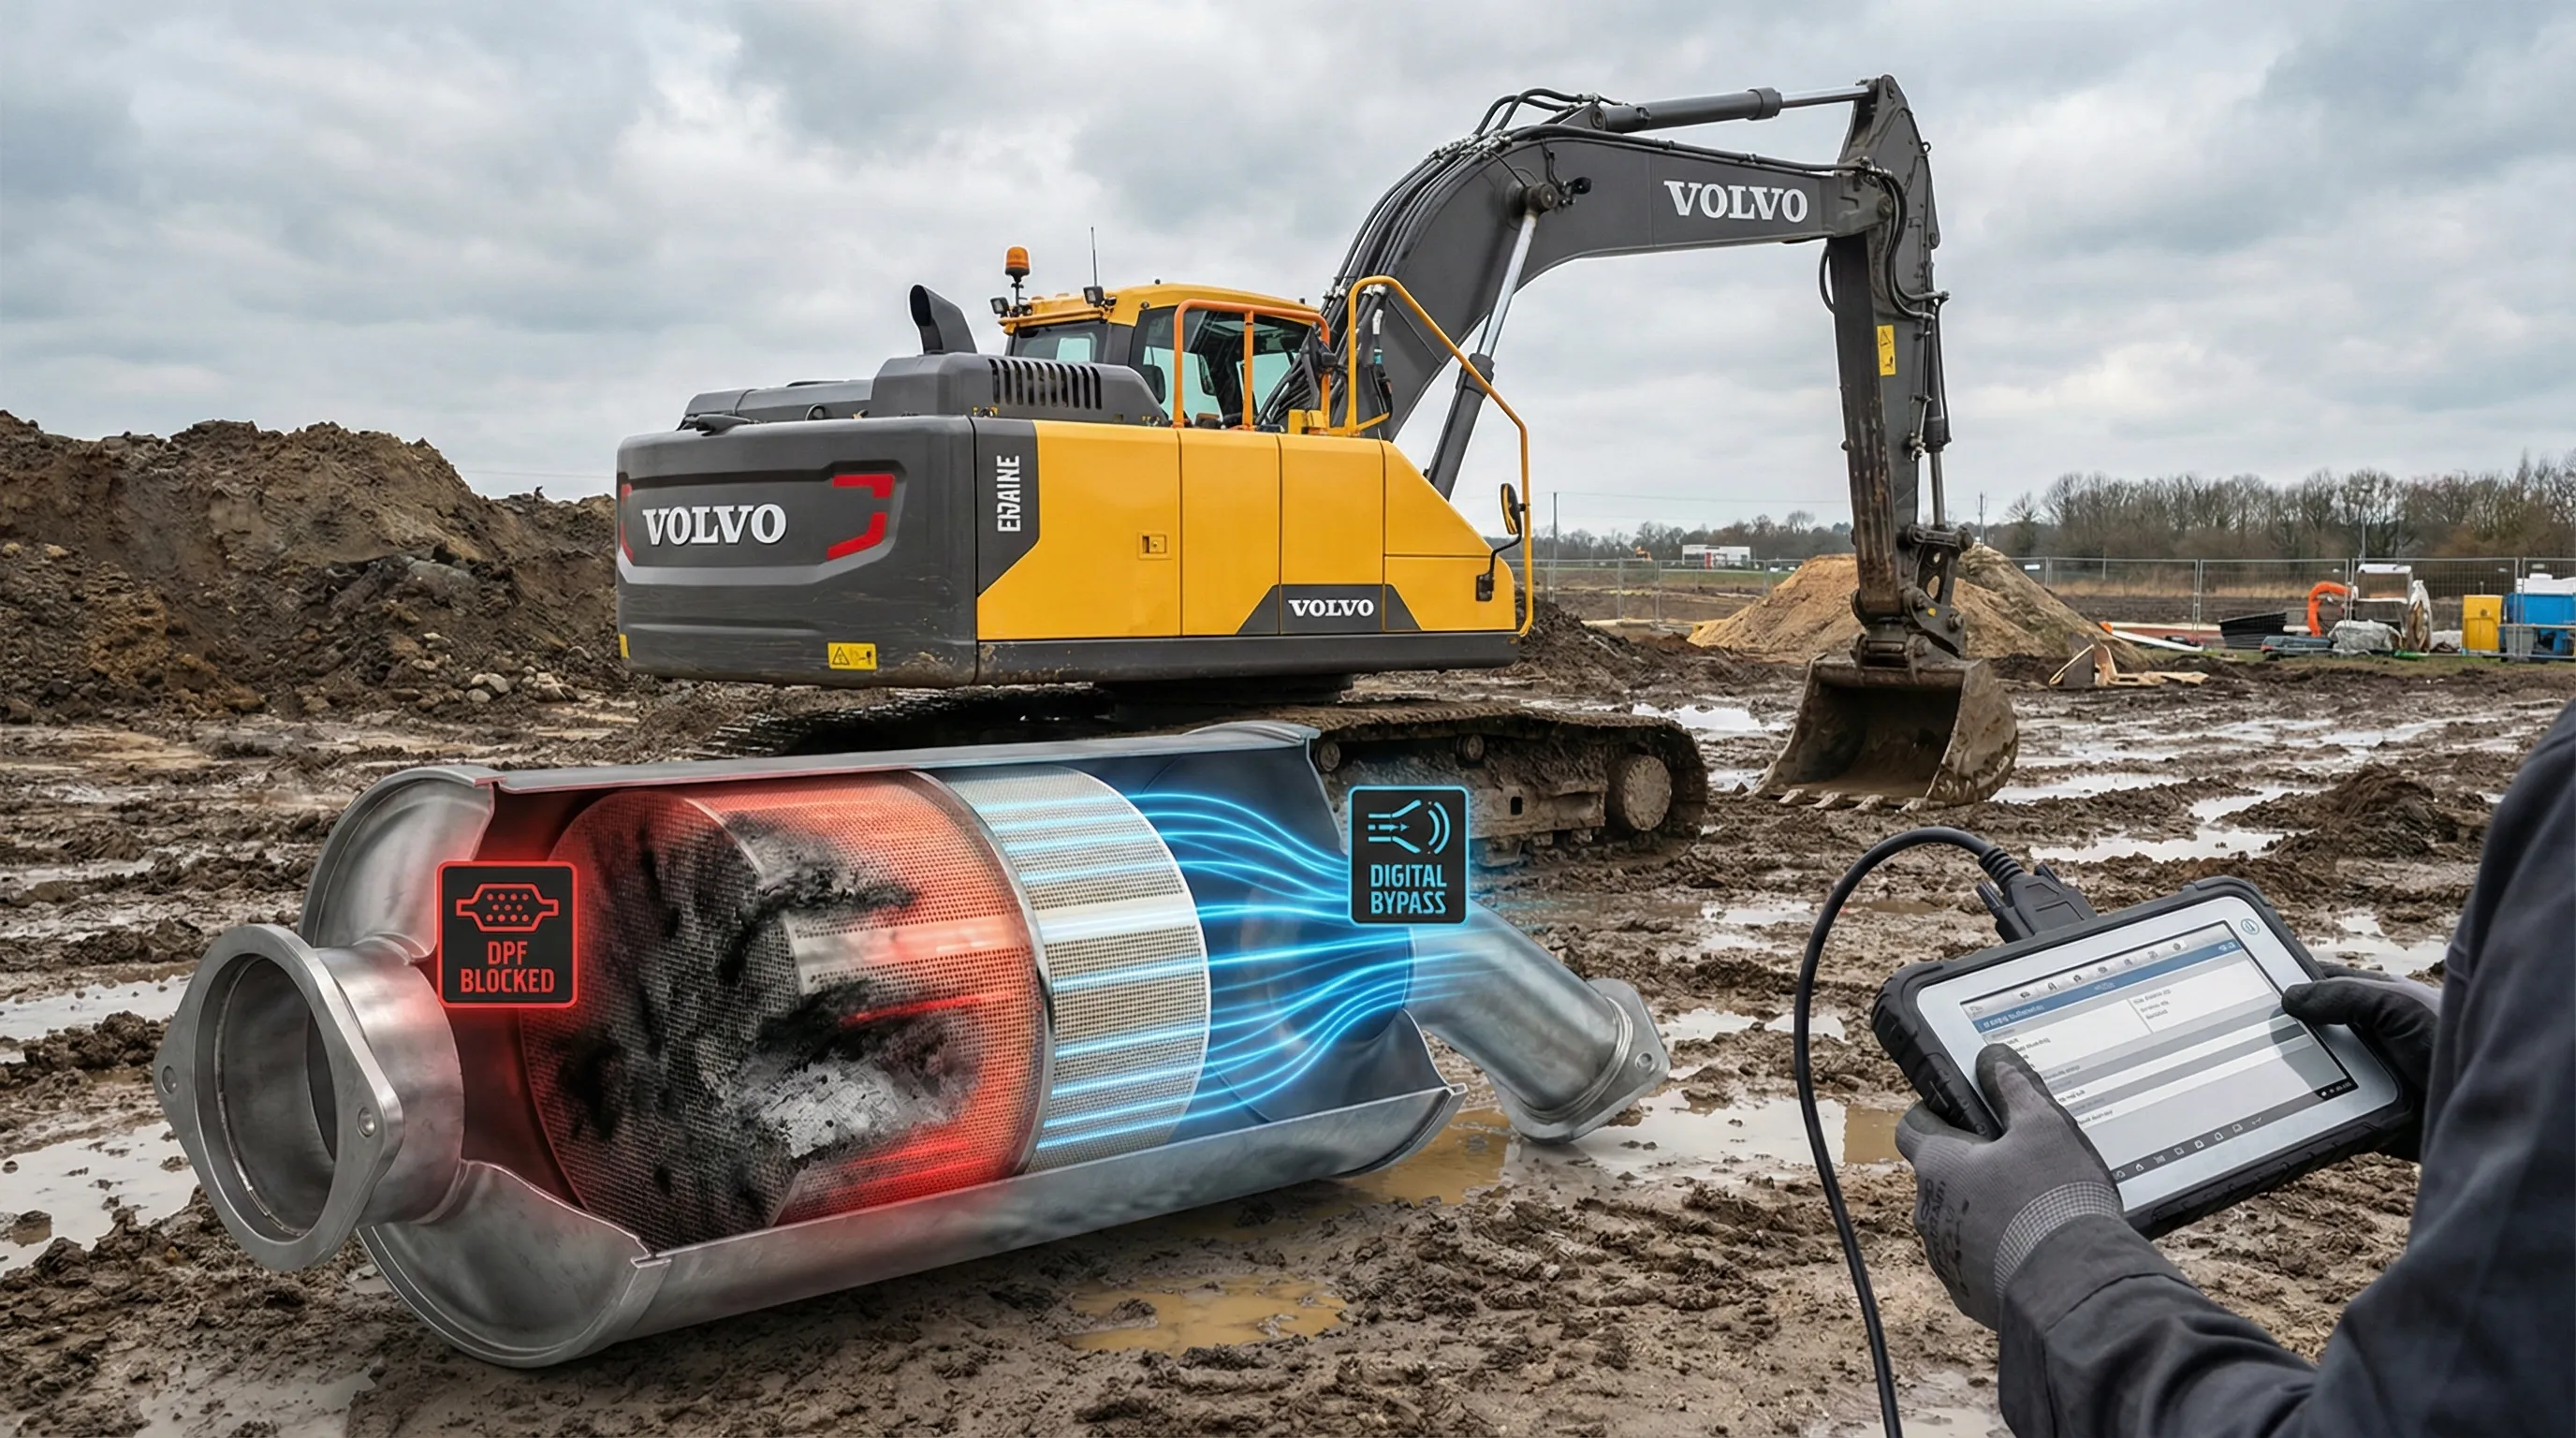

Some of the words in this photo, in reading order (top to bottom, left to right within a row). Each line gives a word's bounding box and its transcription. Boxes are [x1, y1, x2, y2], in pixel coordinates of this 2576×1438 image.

[1663, 180, 1808, 223] VOLVO
[642, 503, 787, 546] VOLVO
[1288, 598, 1374, 617] VOLVO
